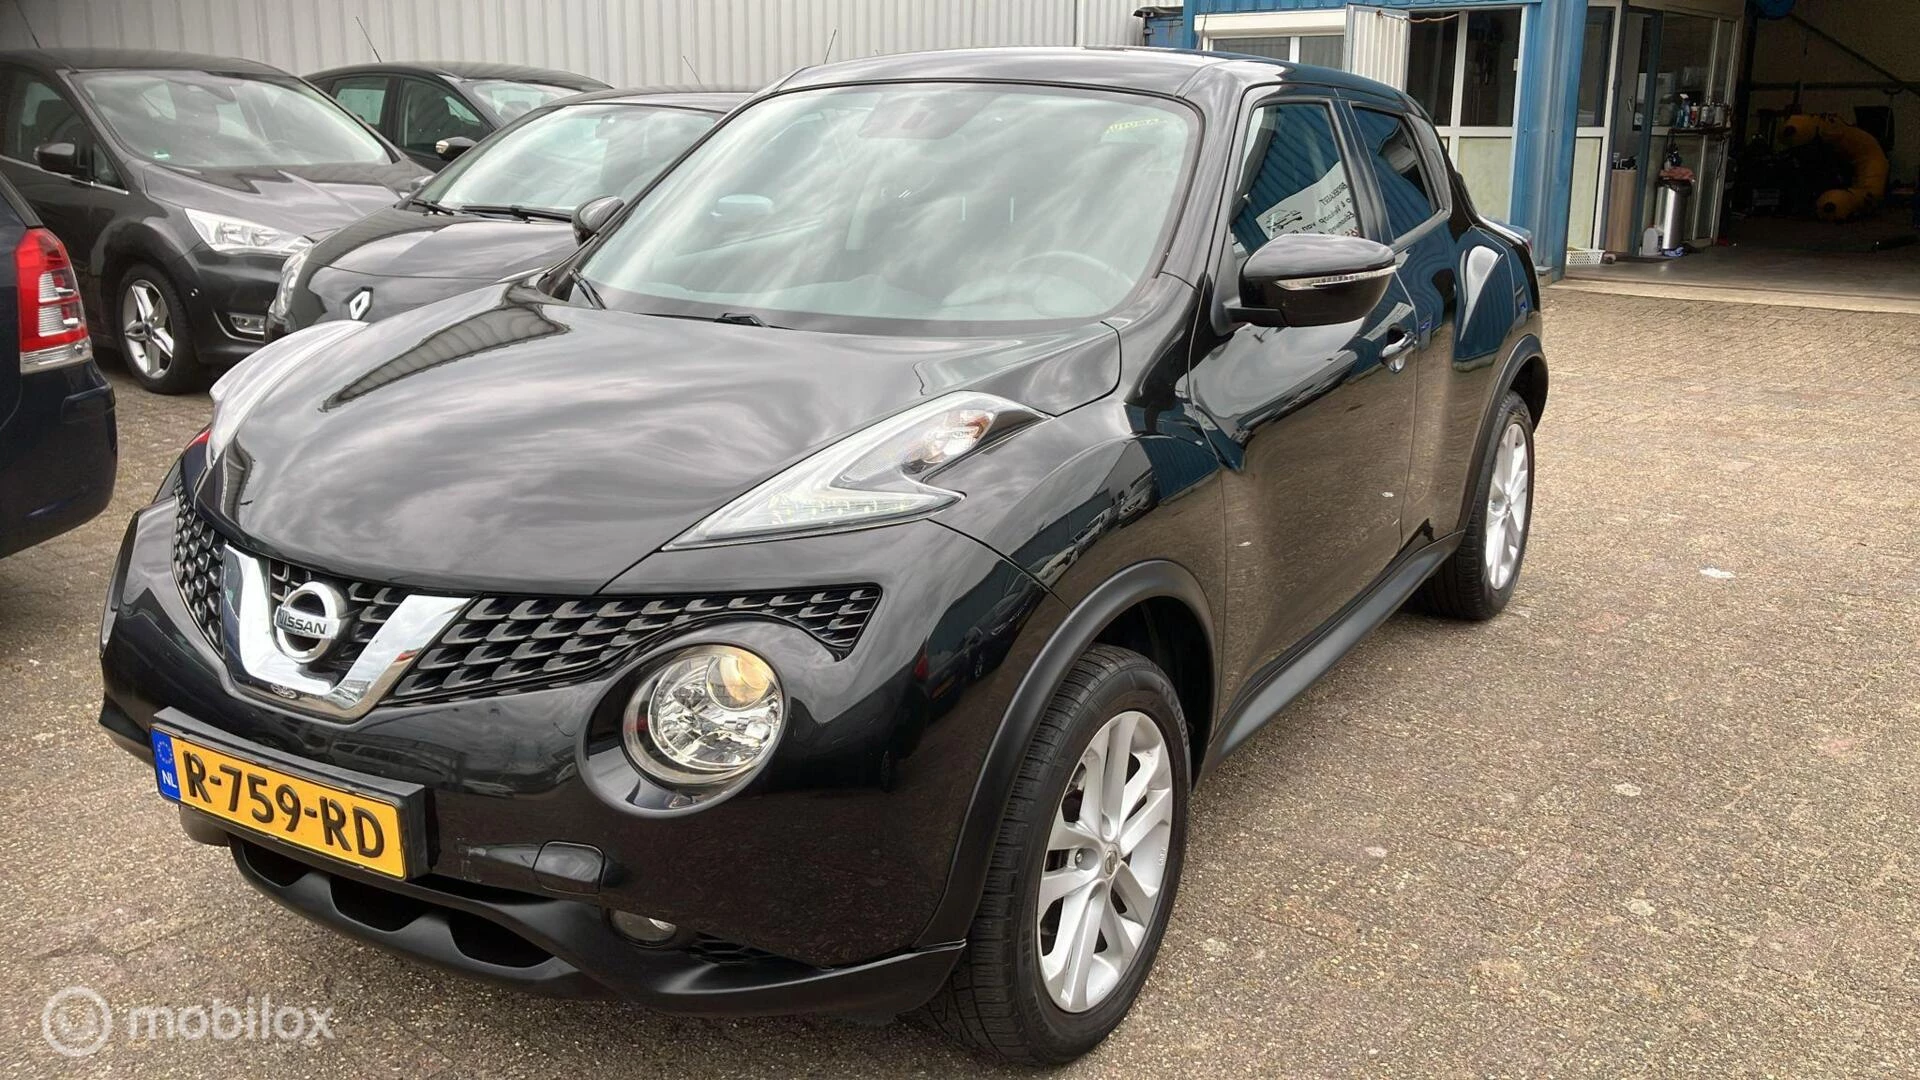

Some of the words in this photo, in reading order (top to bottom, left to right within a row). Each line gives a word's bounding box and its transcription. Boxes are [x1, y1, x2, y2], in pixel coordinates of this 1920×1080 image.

[276, 609, 327, 635] NISSAN
[161, 771, 178, 789] NL
[183, 750, 385, 858] R-759-RD
